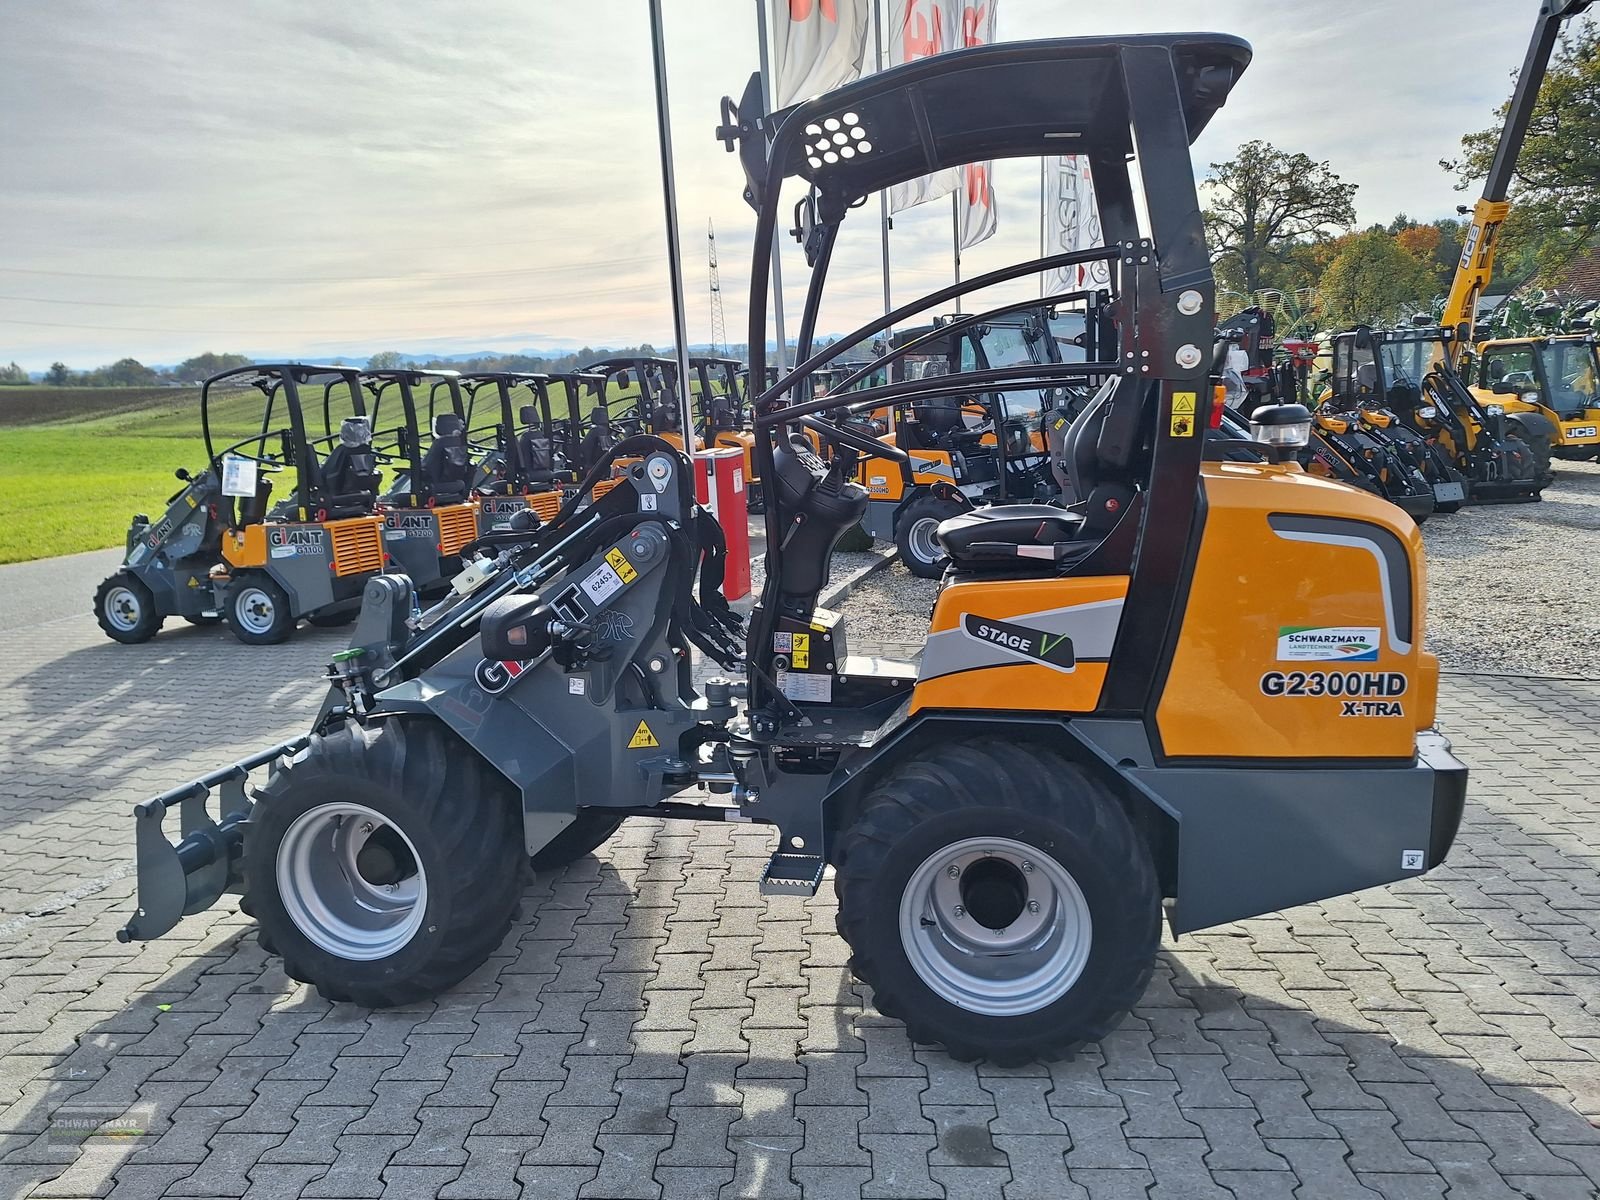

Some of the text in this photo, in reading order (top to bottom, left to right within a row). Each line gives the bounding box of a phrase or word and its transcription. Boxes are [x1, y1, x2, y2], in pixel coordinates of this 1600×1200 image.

[1461, 225, 1480, 269] JCB
[1566, 427, 1597, 438] JCB
[407, 529, 433, 537] G1200
[296, 545, 323, 554] G1100
[591, 572, 613, 591] 62453
[977, 625, 1032, 652] STAGE
[1288, 635, 1366, 643] SCHWARZMAYR
[1260, 671, 1408, 697] G2300HD
[1340, 701, 1404, 717] X-TRA
